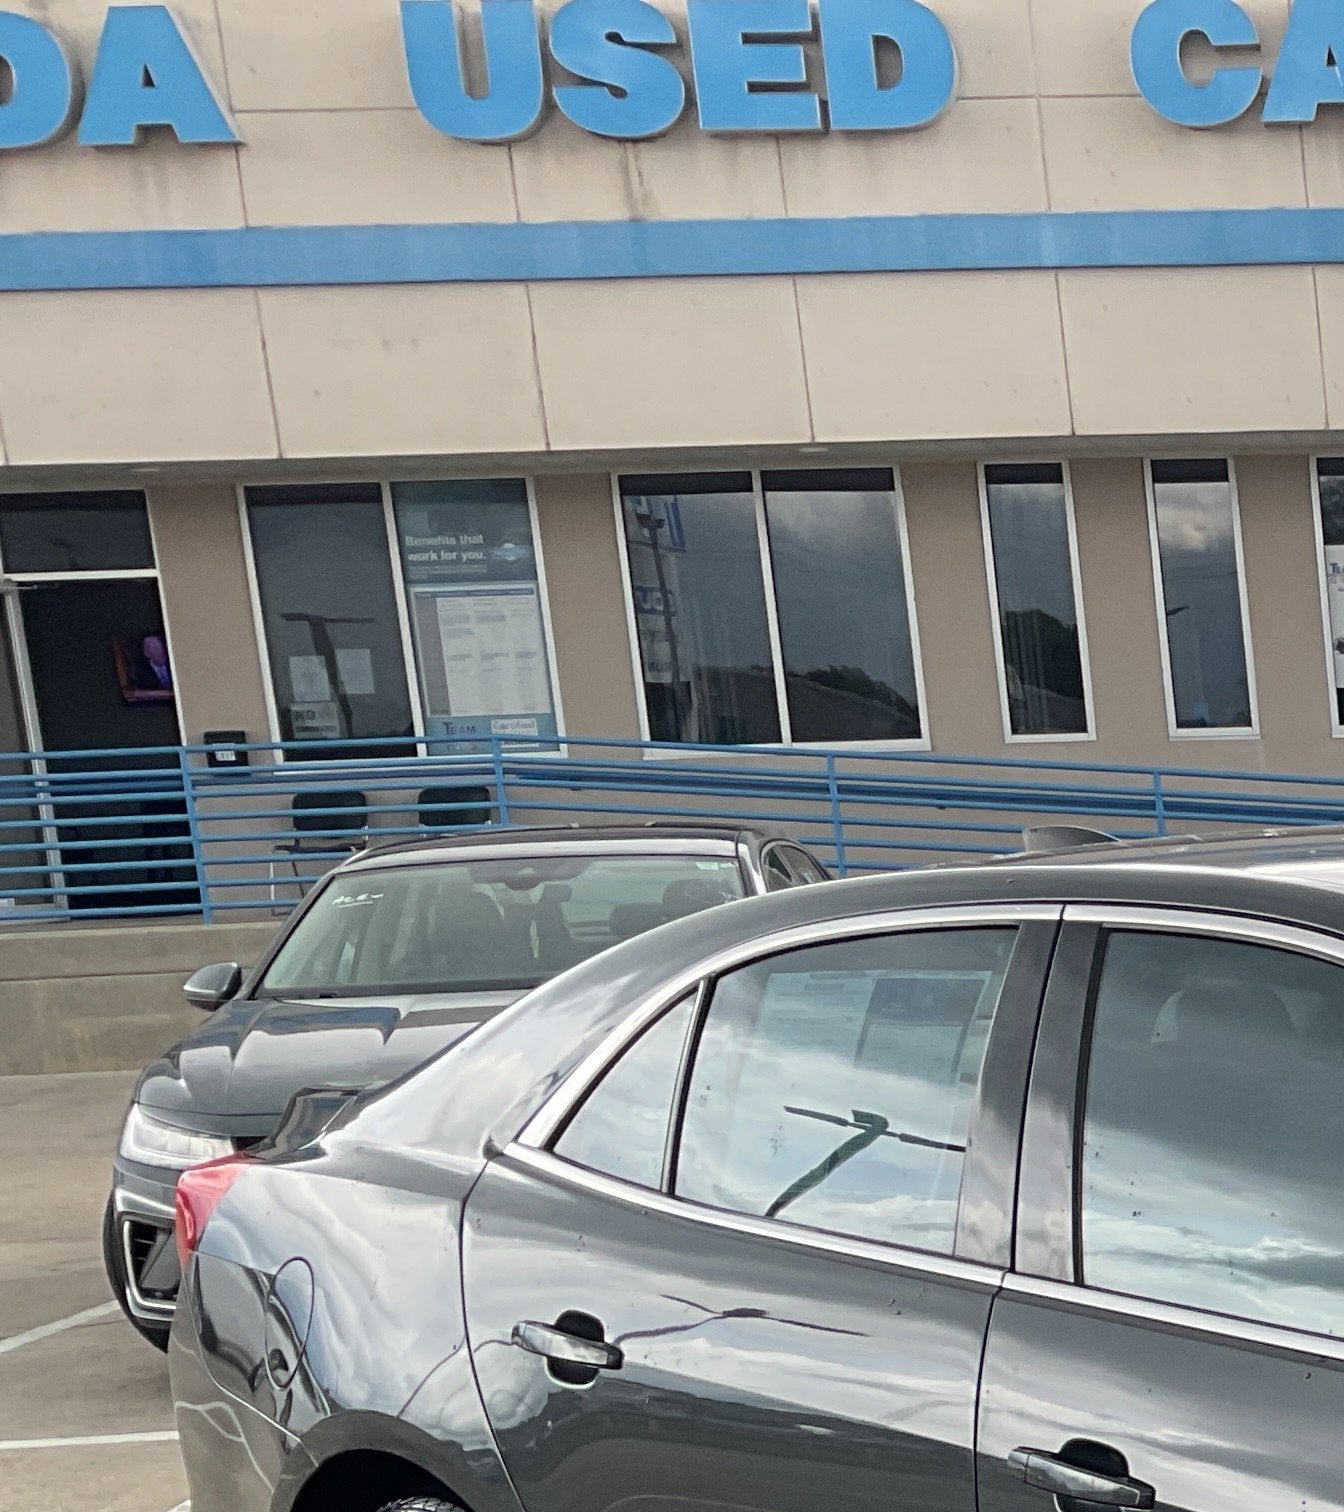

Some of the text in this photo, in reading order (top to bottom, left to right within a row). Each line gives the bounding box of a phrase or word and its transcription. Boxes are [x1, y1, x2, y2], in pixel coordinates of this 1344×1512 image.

[399, 0, 957, 141] USED
[460, 534, 484, 544] that
[408, 550, 438, 561] work
[441, 549, 458, 560] for
